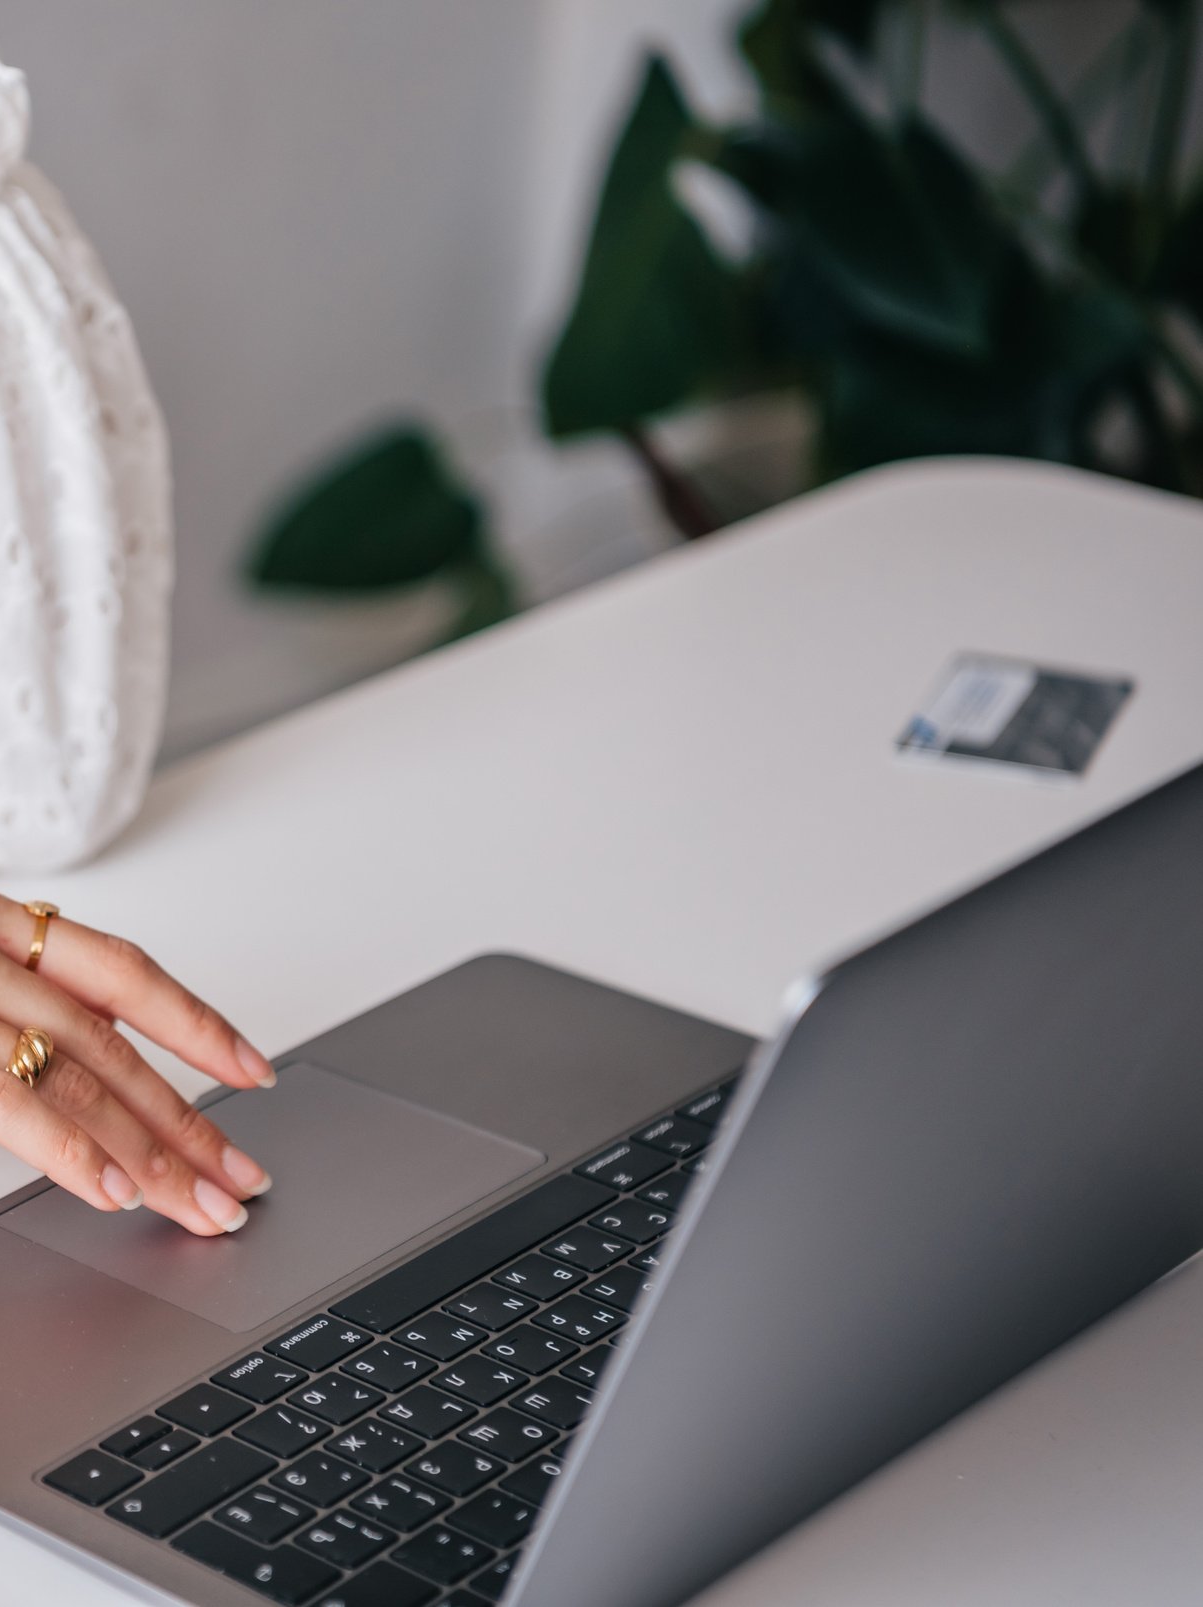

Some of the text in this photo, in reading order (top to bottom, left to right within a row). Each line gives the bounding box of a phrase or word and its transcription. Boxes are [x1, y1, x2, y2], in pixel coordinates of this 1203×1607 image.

[602, 1242, 619, 1254] V
[506, 1273, 527, 1284] И
[594, 1284, 615, 1296] П
[503, 1299, 524, 1310] N
[281, 1318, 329, 1350] command
[545, 1341, 561, 1352] J
[230, 1358, 264, 1379] option
[356, 1363, 375, 1372] Б
[579, 1365, 595, 1376] Г
[444, 1374, 465, 1387] Л
[302, 1390, 326, 1405] Ю
[525, 1394, 550, 1409] Ш
[388, 1404, 412, 1419] Д
[443, 1402, 463, 1412] L
[469, 1426, 499, 1441] Щ
[339, 1436, 366, 1452] Ж
[285, 1472, 307, 1485] Э
